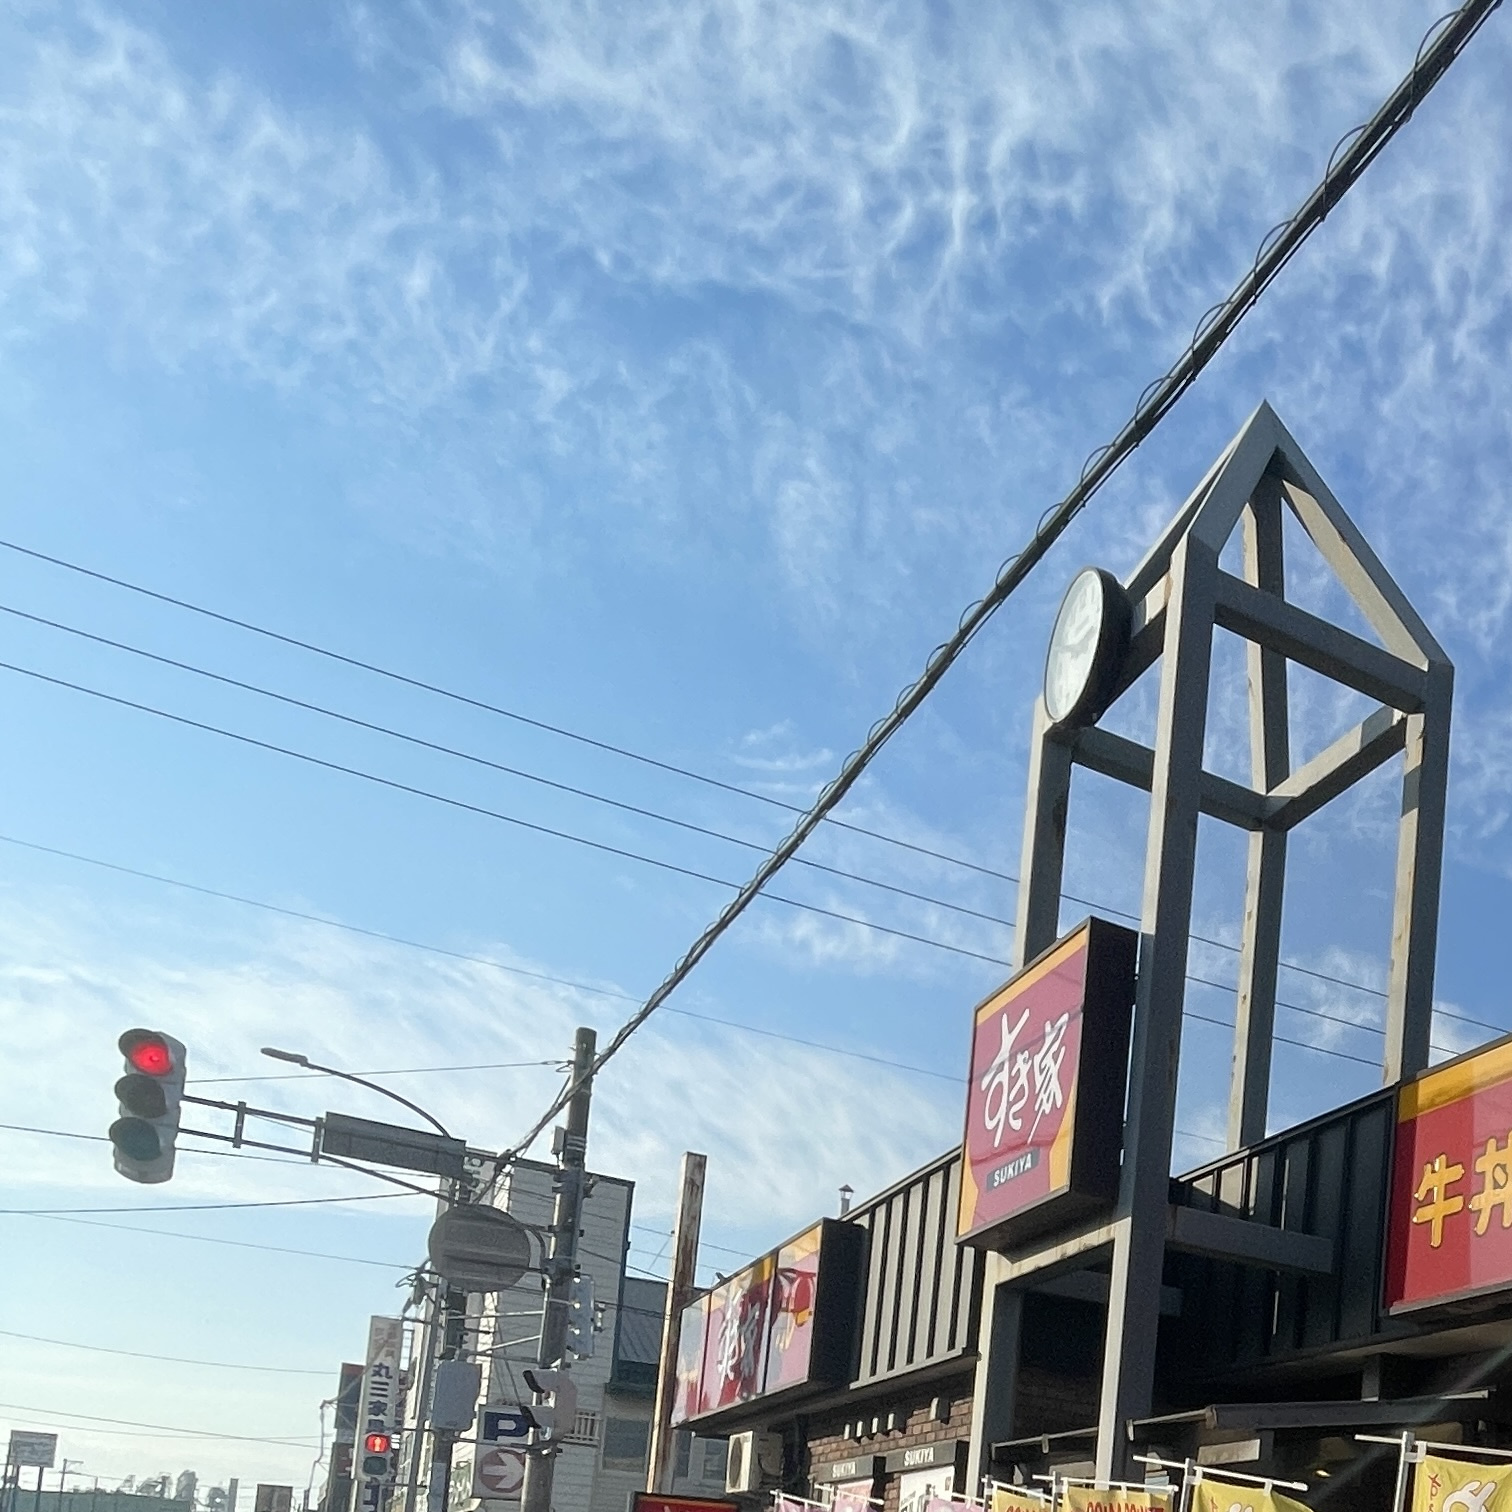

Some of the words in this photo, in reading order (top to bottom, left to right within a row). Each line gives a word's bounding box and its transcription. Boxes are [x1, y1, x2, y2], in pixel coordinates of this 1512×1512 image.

[981, 1007, 1070, 1148] すき家
[993, 1150, 1033, 1188] SUKIYA
[484, 1411, 531, 1442] P
[832, 1461, 857, 1478] SUKIYA
[904, 1447, 935, 1467] SUKIYA
